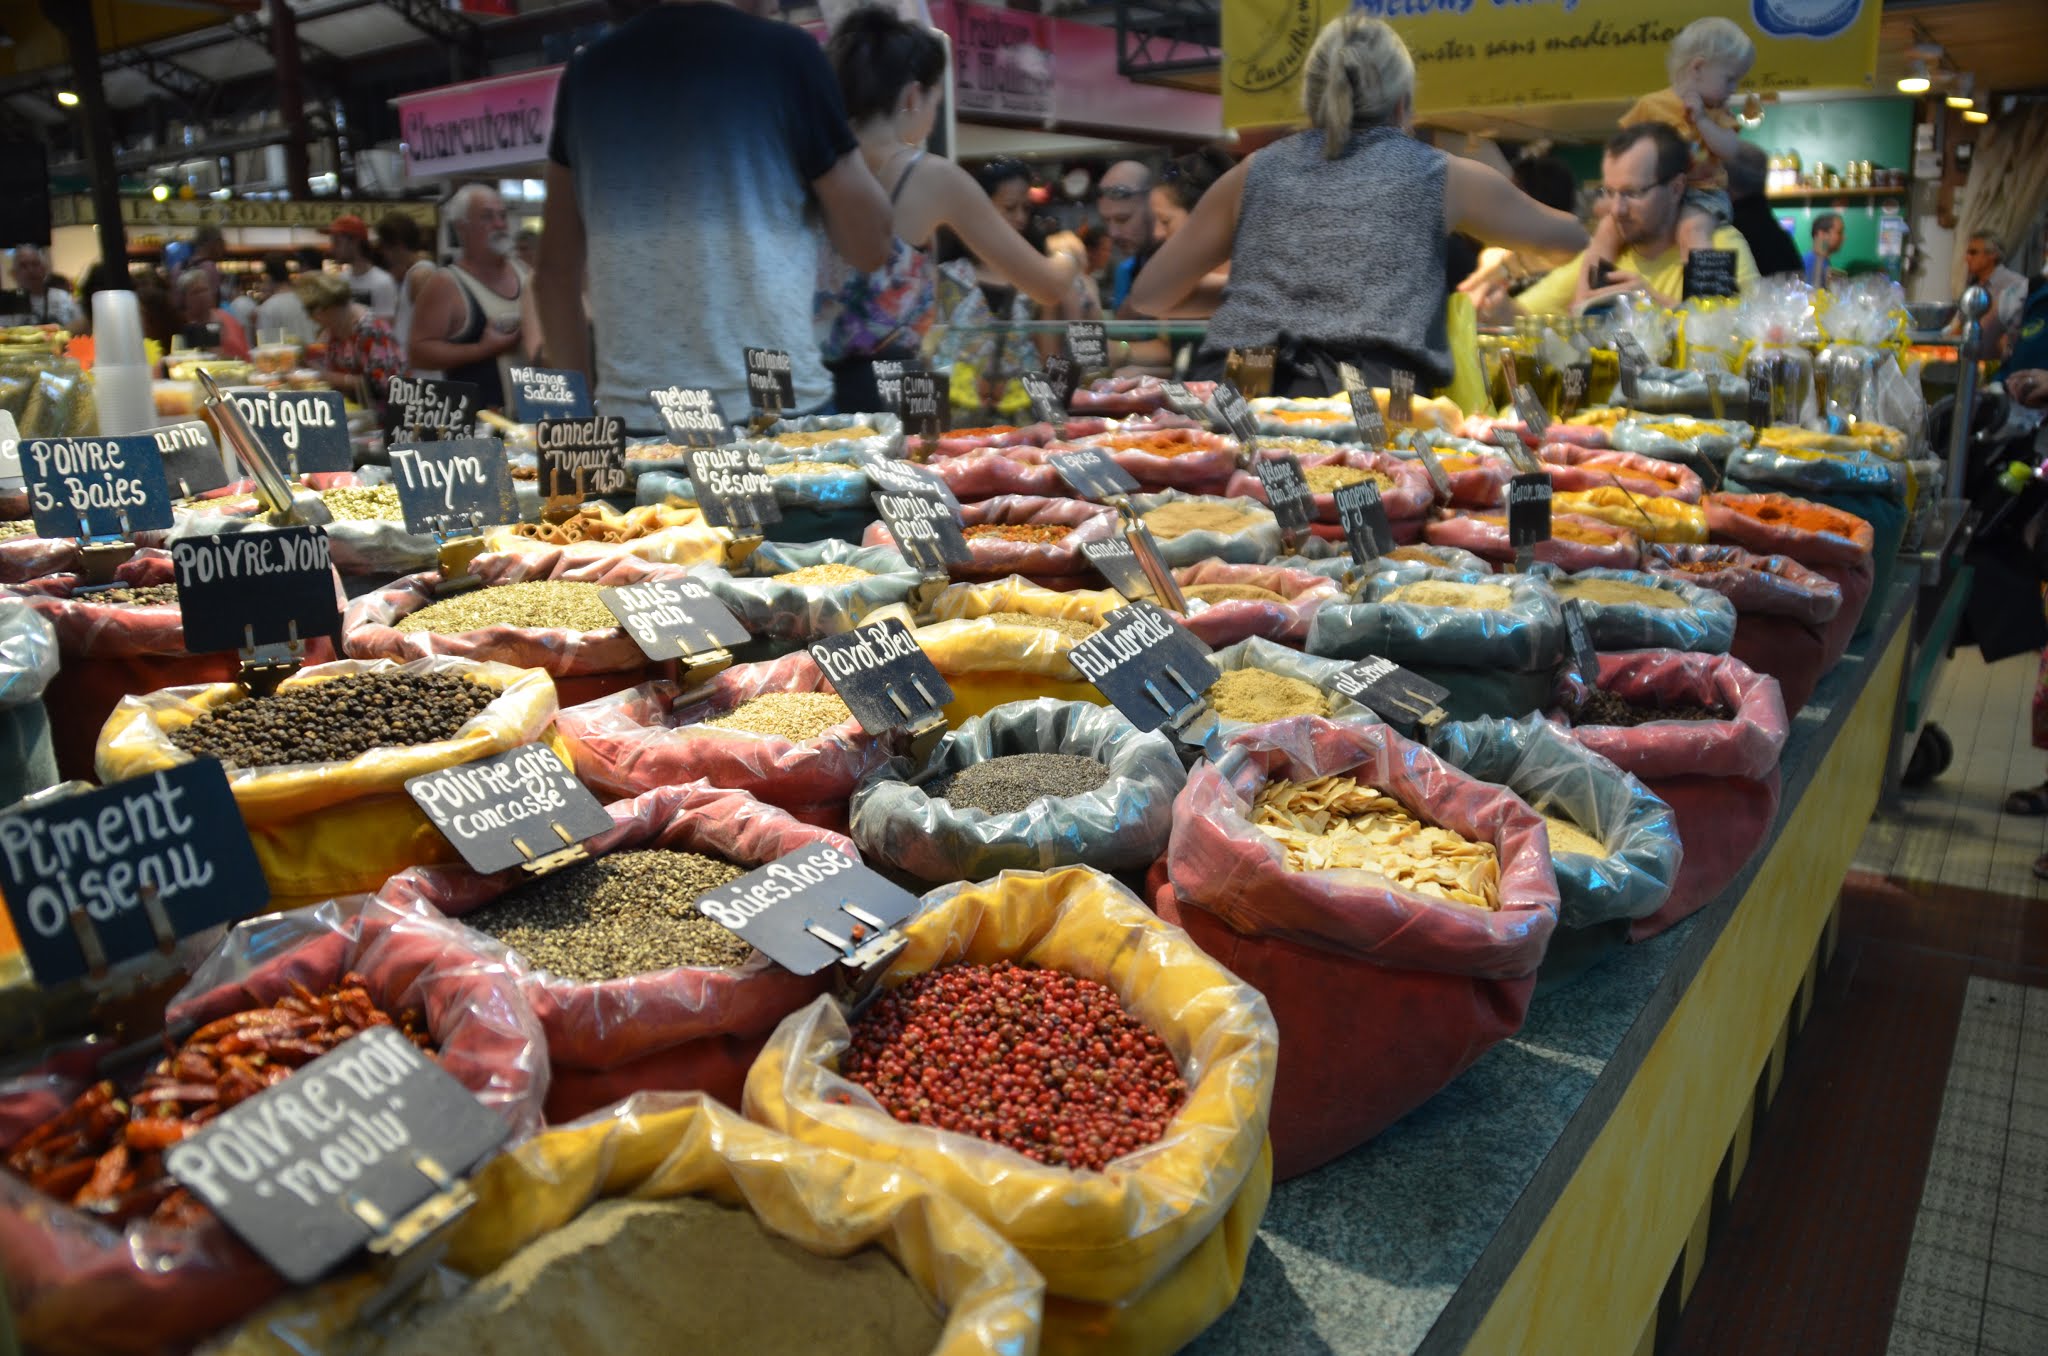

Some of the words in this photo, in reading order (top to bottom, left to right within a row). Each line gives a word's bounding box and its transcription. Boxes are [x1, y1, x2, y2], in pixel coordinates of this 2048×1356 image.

[407, 99, 544, 162] Charcuterie
[510, 366, 567, 391] Mélange
[523, 385, 576, 402] Salade
[537, 416, 619, 449] Cannelle
[661, 405, 725, 430] Poisson
[153, 423, 209, 453] arin
[388, 449, 487, 510] Thym
[692, 449, 744, 483] graine
[747, 449, 764, 468] de
[709, 469, 773, 495] Sésame
[64, 472, 147, 511] Baies
[933, 501, 951, 517] en
[615, 582, 682, 611] Anis
[679, 582, 711, 598] en
[627, 603, 694, 643] grain
[0, 770, 194, 884] Piment
[27, 843, 214, 938] oiseau
[325, 1029, 422, 1101] noir
